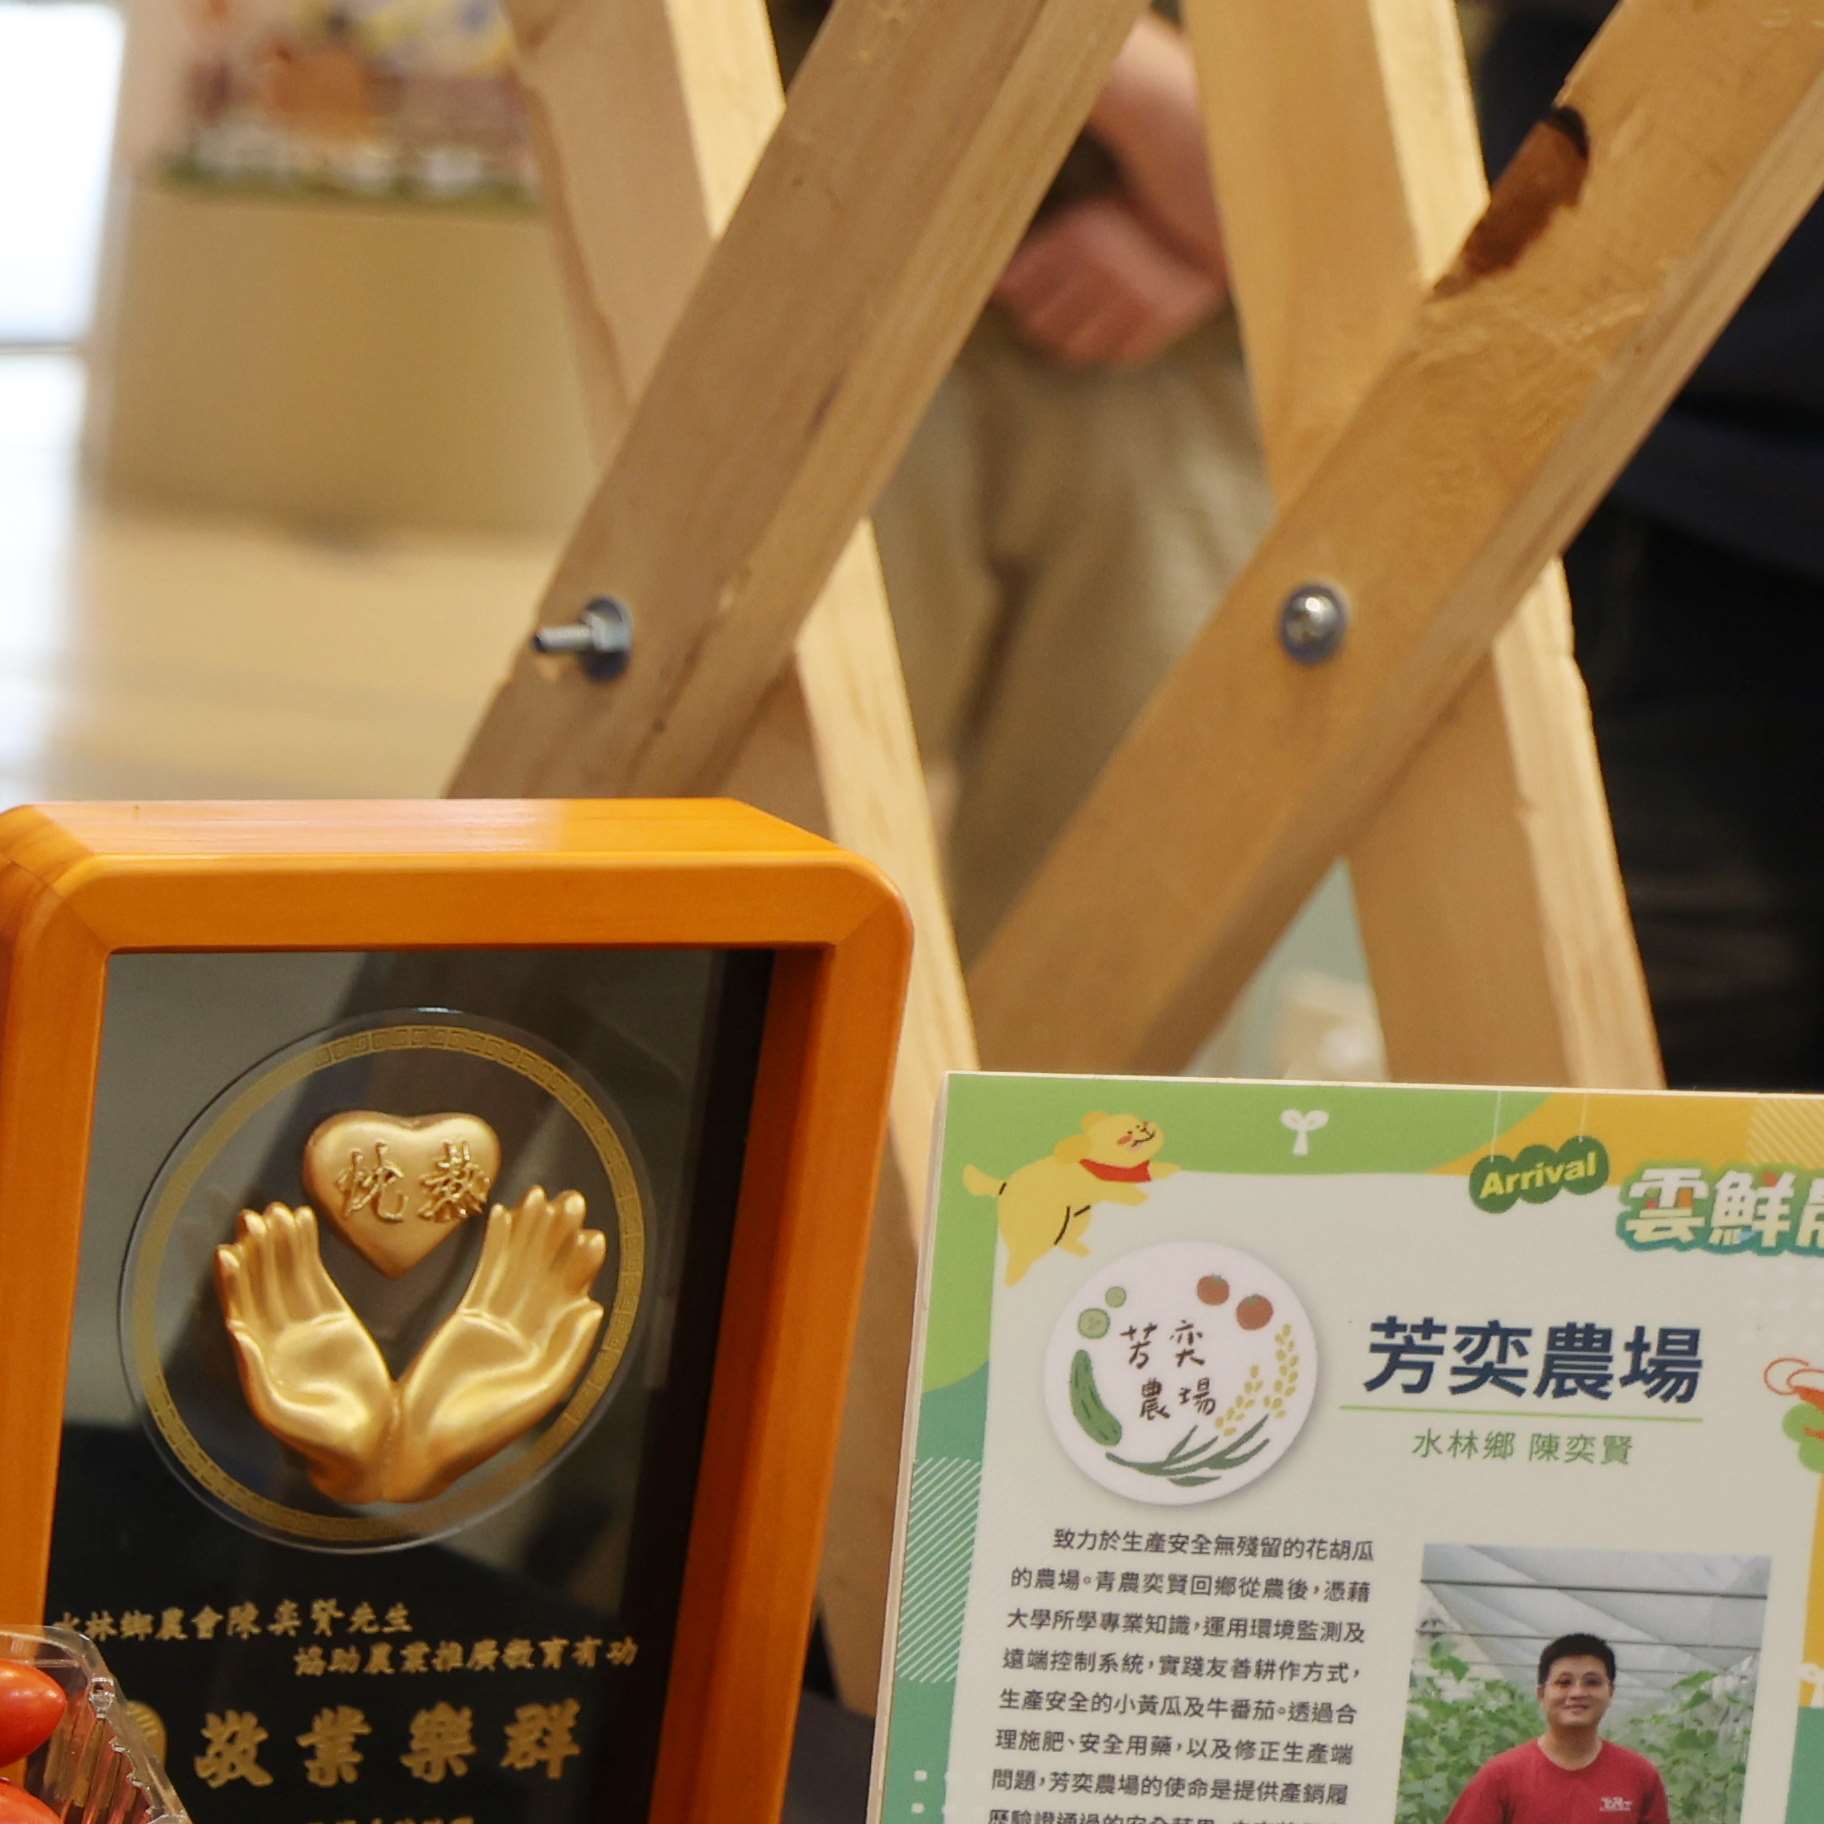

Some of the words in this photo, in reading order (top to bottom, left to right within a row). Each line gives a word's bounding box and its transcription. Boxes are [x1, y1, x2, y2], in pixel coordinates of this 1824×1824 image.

[1479, 1152, 1596, 1199] Arrival
[1120, 1320, 1205, 1369] 芳奕
[1363, 1316, 1703, 1404] 芳奕農場
[1139, 1377, 1216, 1421] 農場
[1413, 1428, 1515, 1461] 水林鄉
[1528, 1432, 1633, 1465] 陳奕賢
[1053, 1527, 1375, 1562] 致力於生產安全無殘留的花胡瓜
[194, 1698, 581, 1789] 敬業樂群
